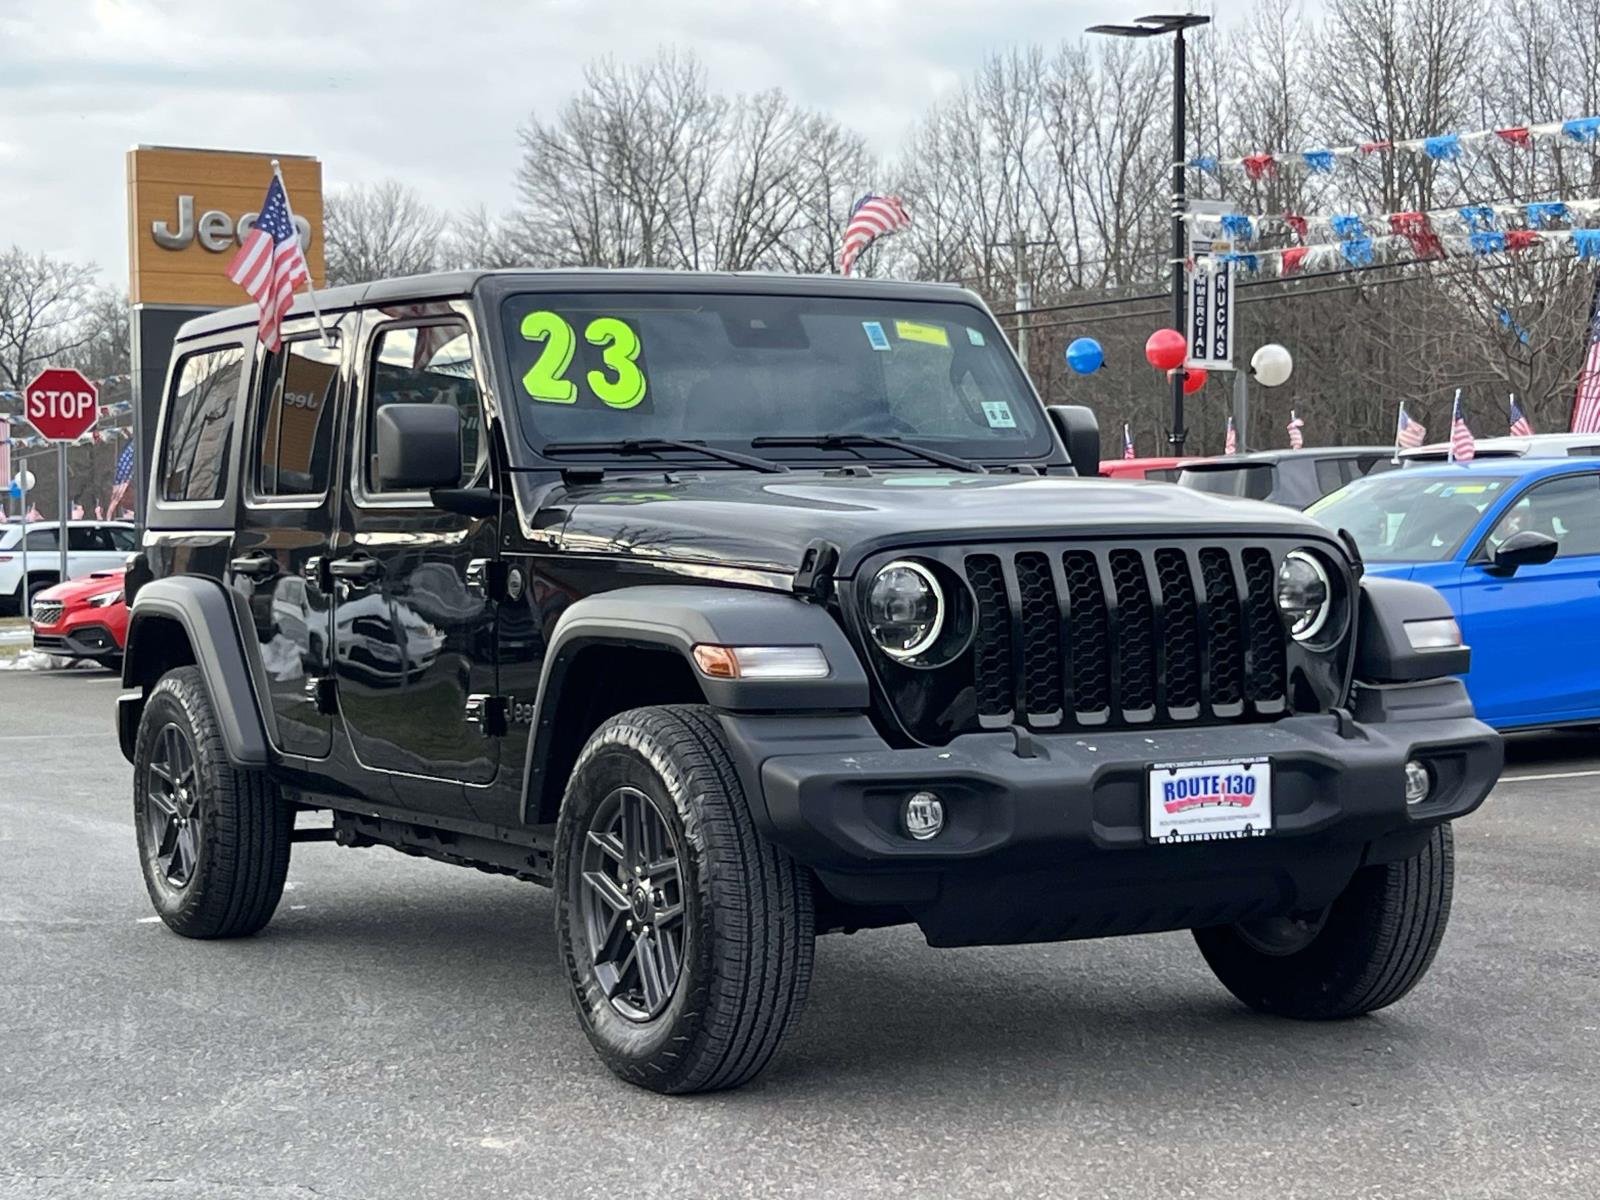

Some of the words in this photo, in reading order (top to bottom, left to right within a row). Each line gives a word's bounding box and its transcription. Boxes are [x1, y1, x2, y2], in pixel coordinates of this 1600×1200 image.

[1195, 266, 1206, 357] MMERCIAL
[1216, 262, 1227, 357] RUCKS
[520, 310, 647, 410] 23
[30, 391, 93, 419] STOP
[503, 695, 535, 725] Jee
[1163, 775, 1220, 802] ROUTE
[1224, 774, 1256, 796] 130
